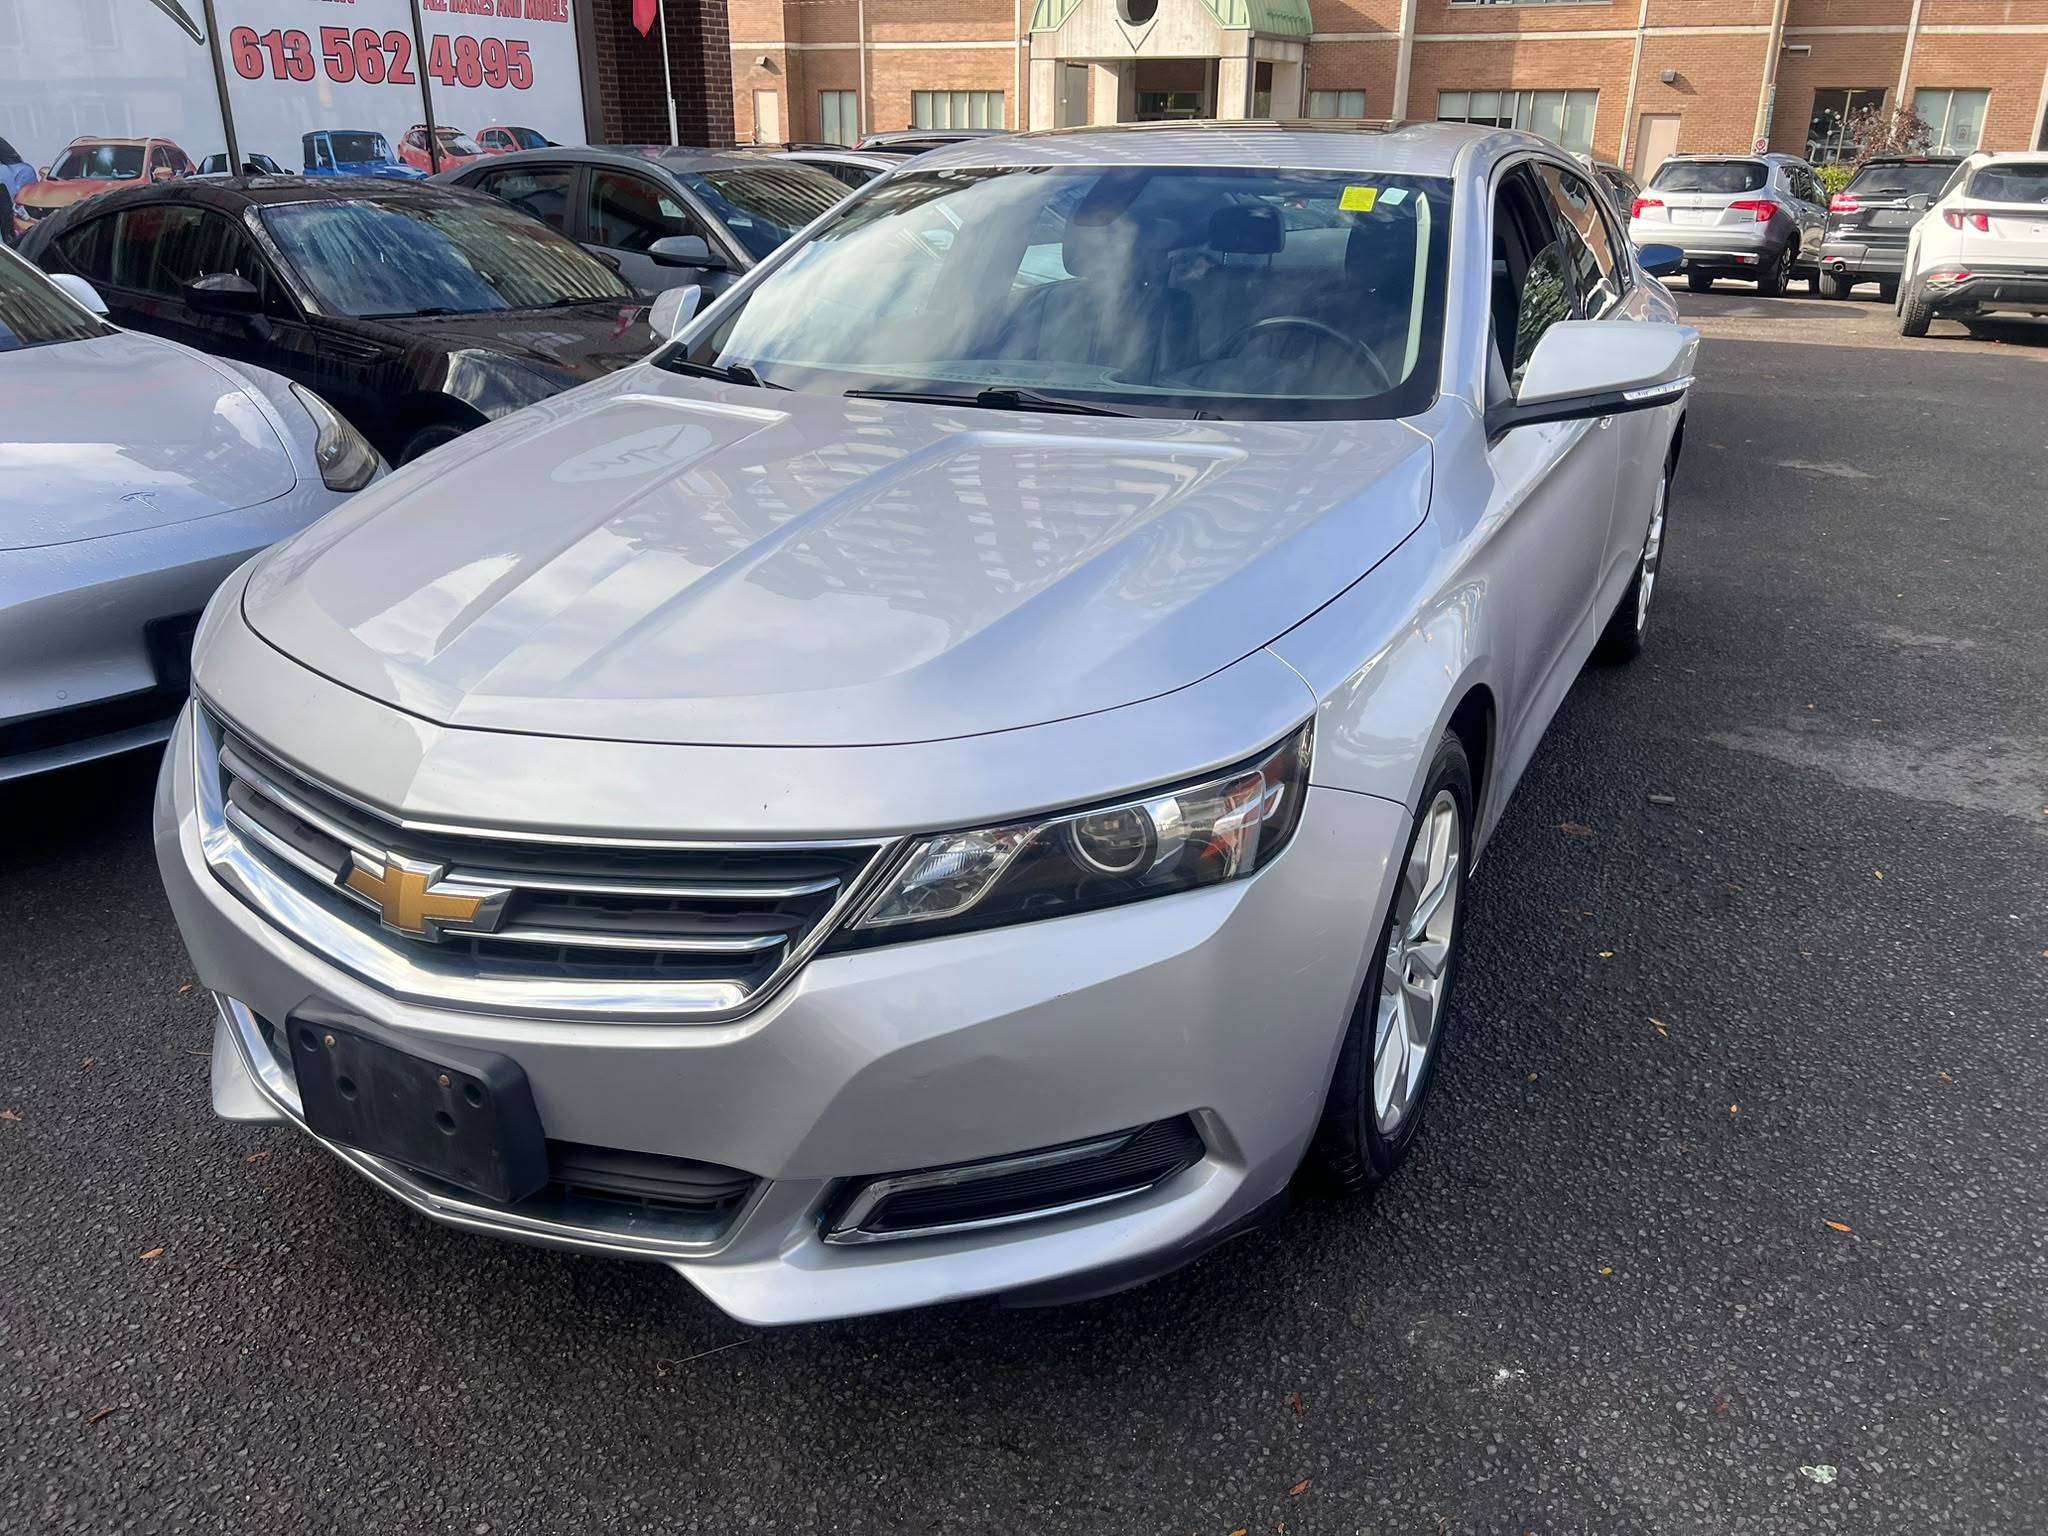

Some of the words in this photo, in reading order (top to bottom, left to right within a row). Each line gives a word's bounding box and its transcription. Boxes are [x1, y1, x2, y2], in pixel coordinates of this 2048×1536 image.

[496, 0, 522, 18] AND
[524, 0, 568, 23] MODELS
[229, 25, 316, 82] 613
[319, 25, 416, 84] 562
[428, 34, 534, 90] 4895
